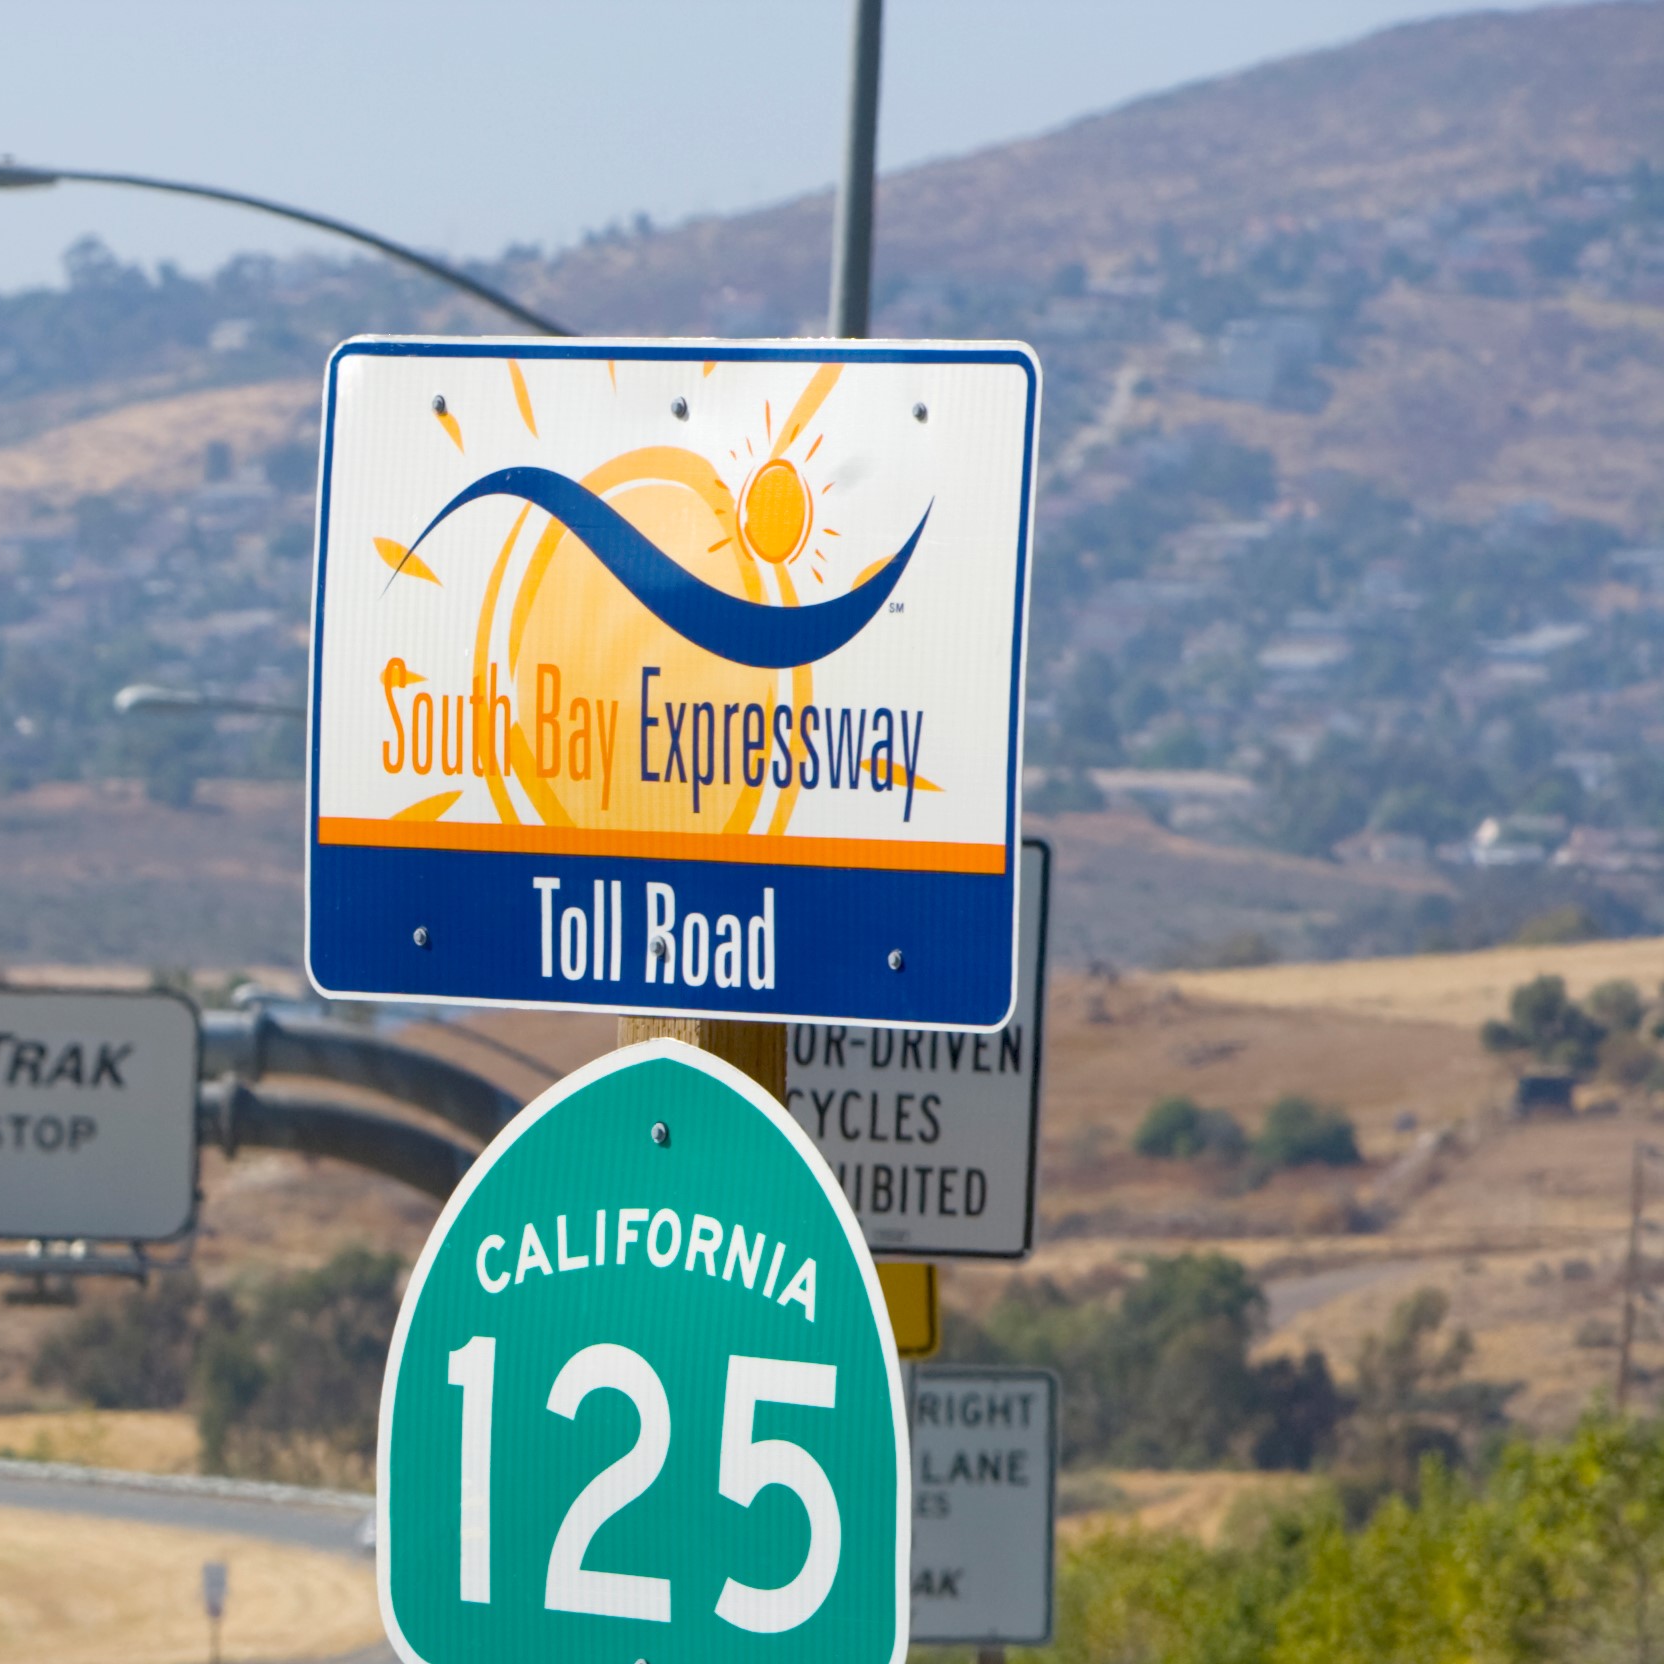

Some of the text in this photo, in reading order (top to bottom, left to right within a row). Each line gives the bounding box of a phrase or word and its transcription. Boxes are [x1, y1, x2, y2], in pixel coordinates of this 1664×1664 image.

[889, 602, 905, 614] SM
[382, 657, 924, 823] South Bay Expressway
[533, 876, 775, 991] Toll Road
[476, 1208, 817, 1323] CALIFORNIA
[917, 1390, 1035, 1429] RIGHT
[447, 1336, 842, 1634] 125
[921, 1448, 1029, 1488] LANE
